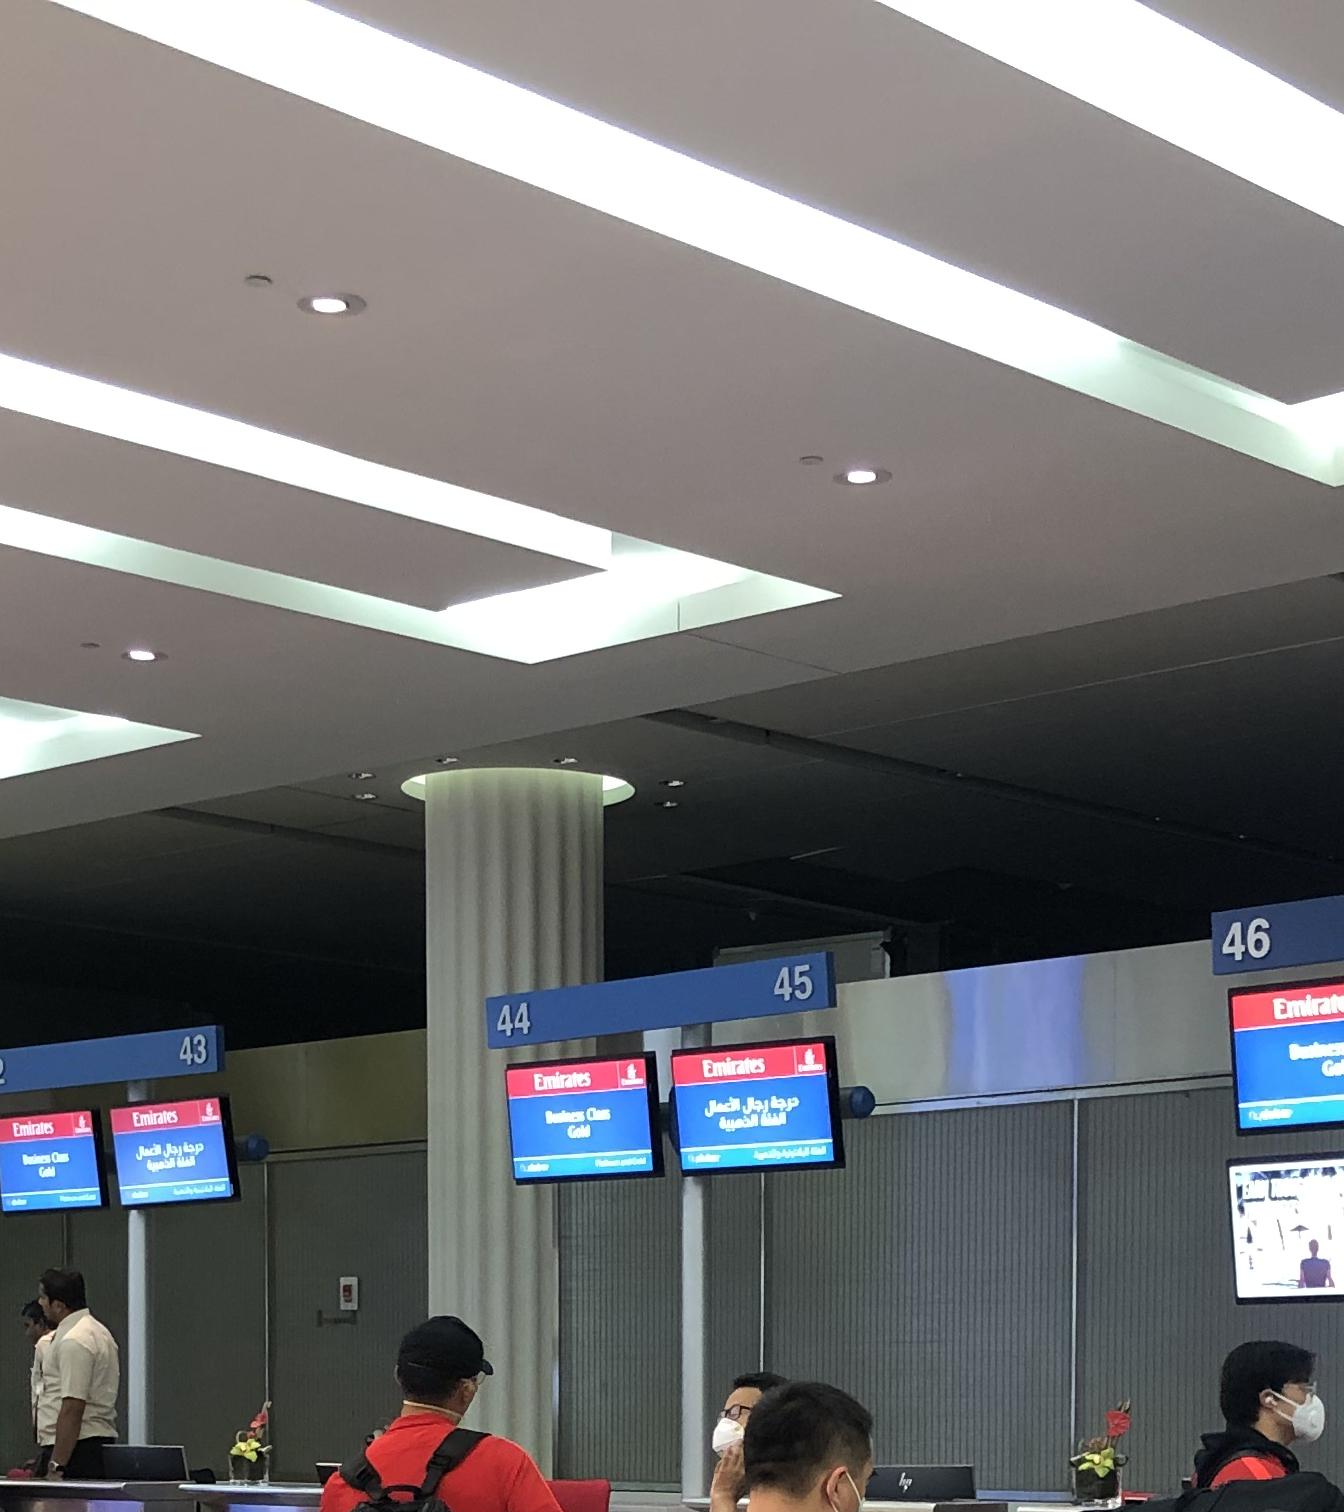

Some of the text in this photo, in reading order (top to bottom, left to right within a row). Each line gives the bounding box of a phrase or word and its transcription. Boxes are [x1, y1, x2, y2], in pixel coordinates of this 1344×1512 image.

[1222, 918, 1271, 960] 46
[773, 963, 813, 1002] 45
[496, 1001, 531, 1037] 44
[178, 1033, 207, 1065] 43
[701, 1057, 765, 1078] Emirates
[533, 1071, 591, 1091] Emirates
[12, 1121, 54, 1137] Emirates
[132, 1110, 178, 1127] Emirates
